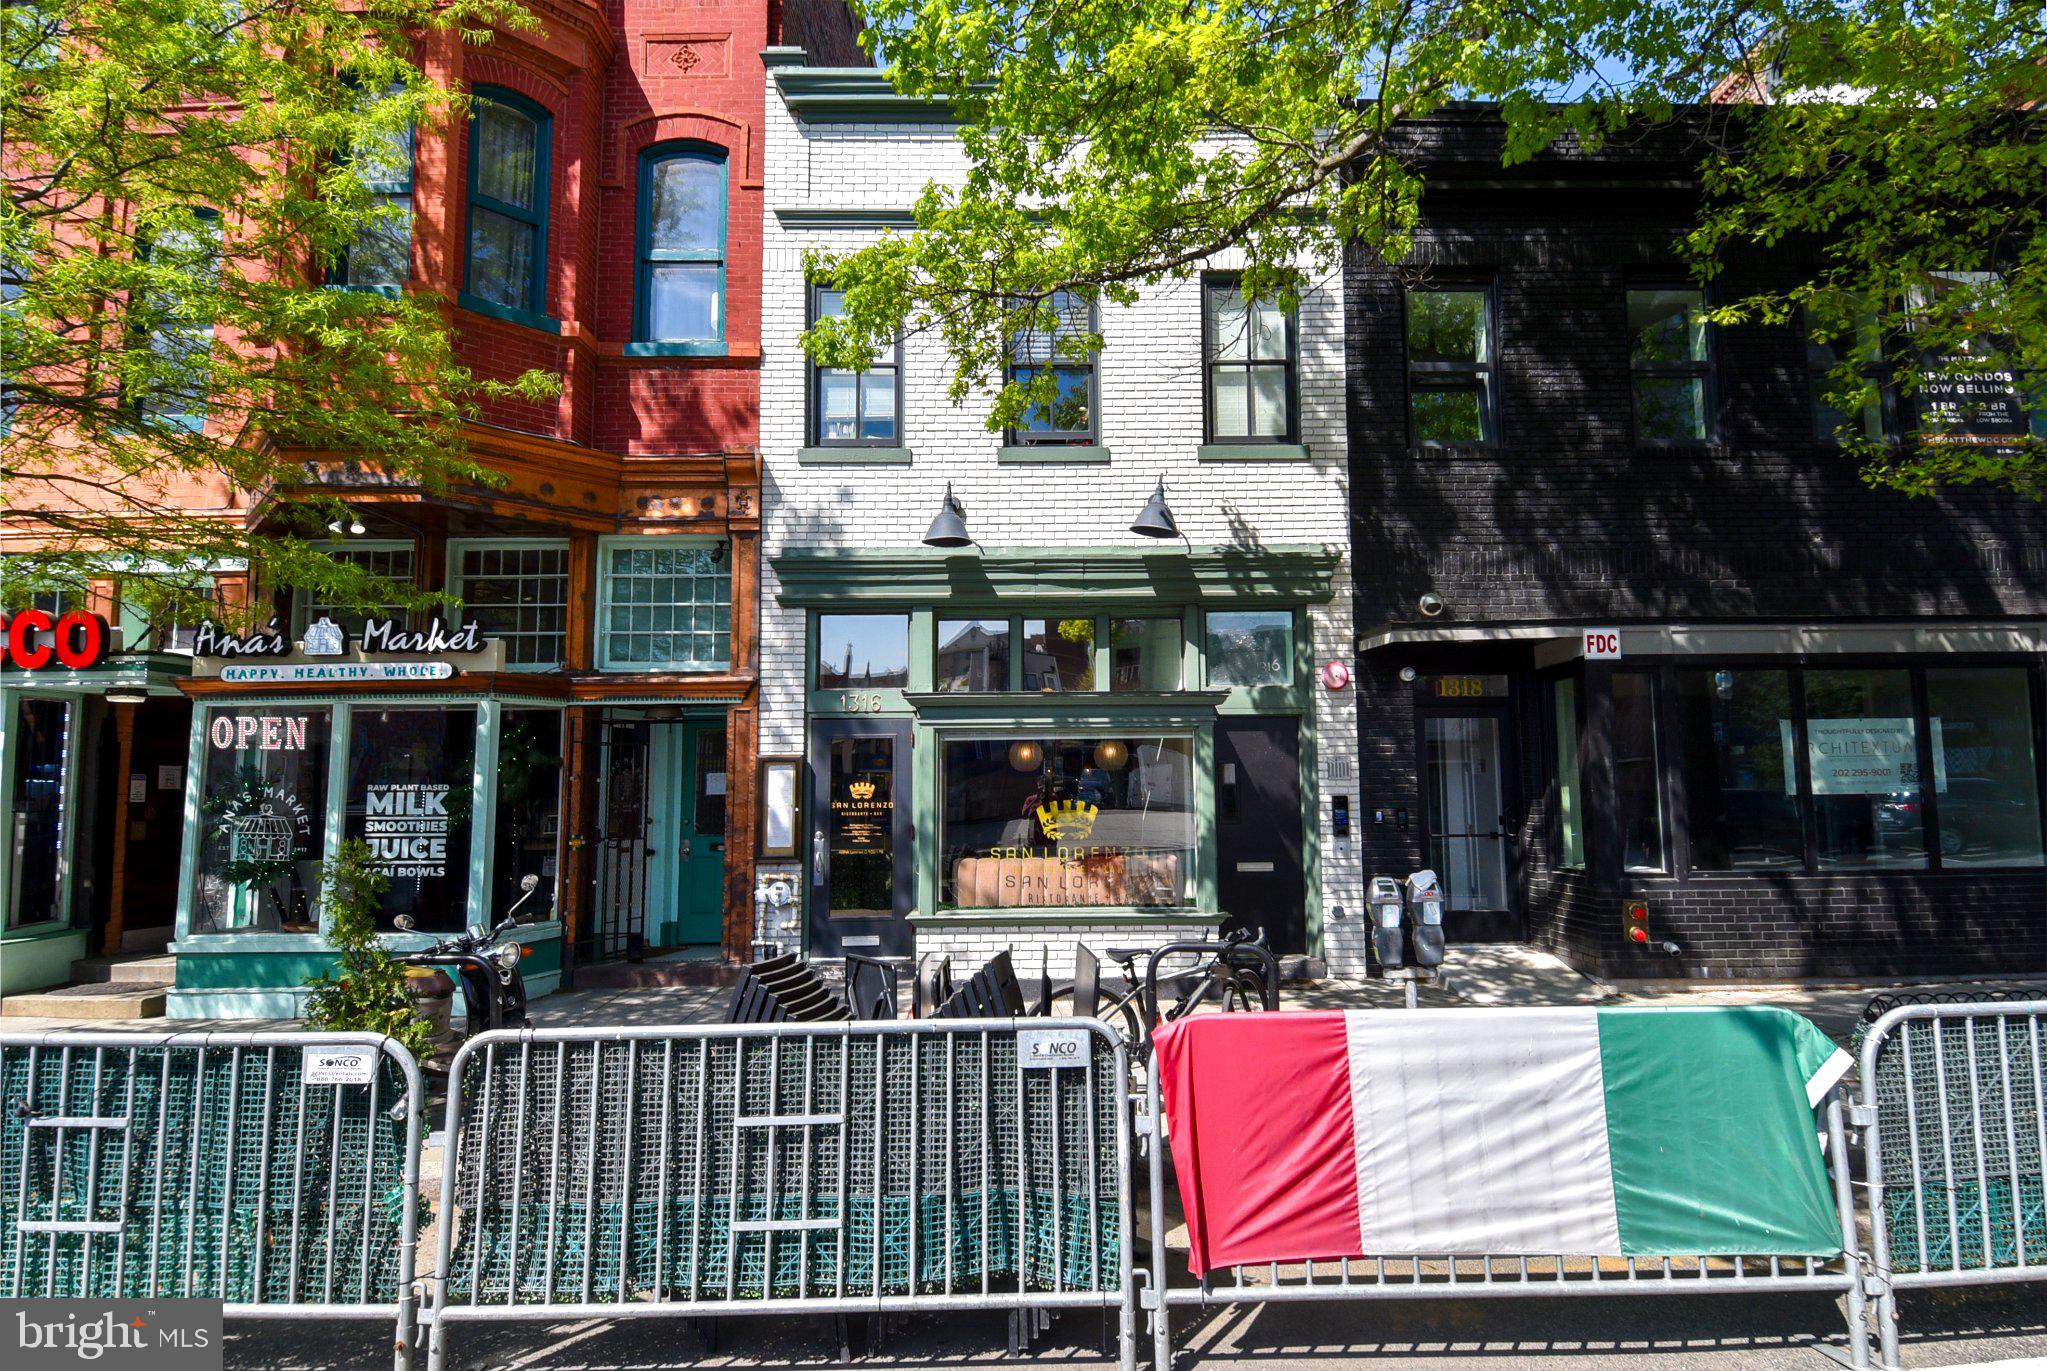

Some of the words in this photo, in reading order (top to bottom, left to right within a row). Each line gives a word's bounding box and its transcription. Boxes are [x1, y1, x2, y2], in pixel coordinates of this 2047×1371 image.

[0, 609, 101, 669] CO
[196, 616, 285, 655] Ana's
[362, 617, 481, 653] Market
[1586, 634, 1618, 654] FDC
[225, 668, 285, 681] HAPPY.
[294, 666, 374, 679] HEALTHY.
[383, 664, 445, 677] WHOLE.
[1441, 677, 1483, 697] 1318
[839, 693, 882, 713] 1316
[211, 715, 308, 750] OPEN
[1831, 769, 1850, 777] 202
[367, 784, 388, 792] RAW
[218, 791, 253, 834] ANA'S
[263, 786, 311, 835] MARKET
[365, 791, 449, 815] MILK
[831, 801, 849, 809] SAN
[851, 801, 894, 809] LORENZO
[365, 820, 448, 832] SMOOTHIES
[365, 838, 447, 859] JUICE
[990, 846, 1034, 860] SAN
[397, 866, 446, 878] BOWLS
[1031, 1042, 1077, 1055] SNCO
